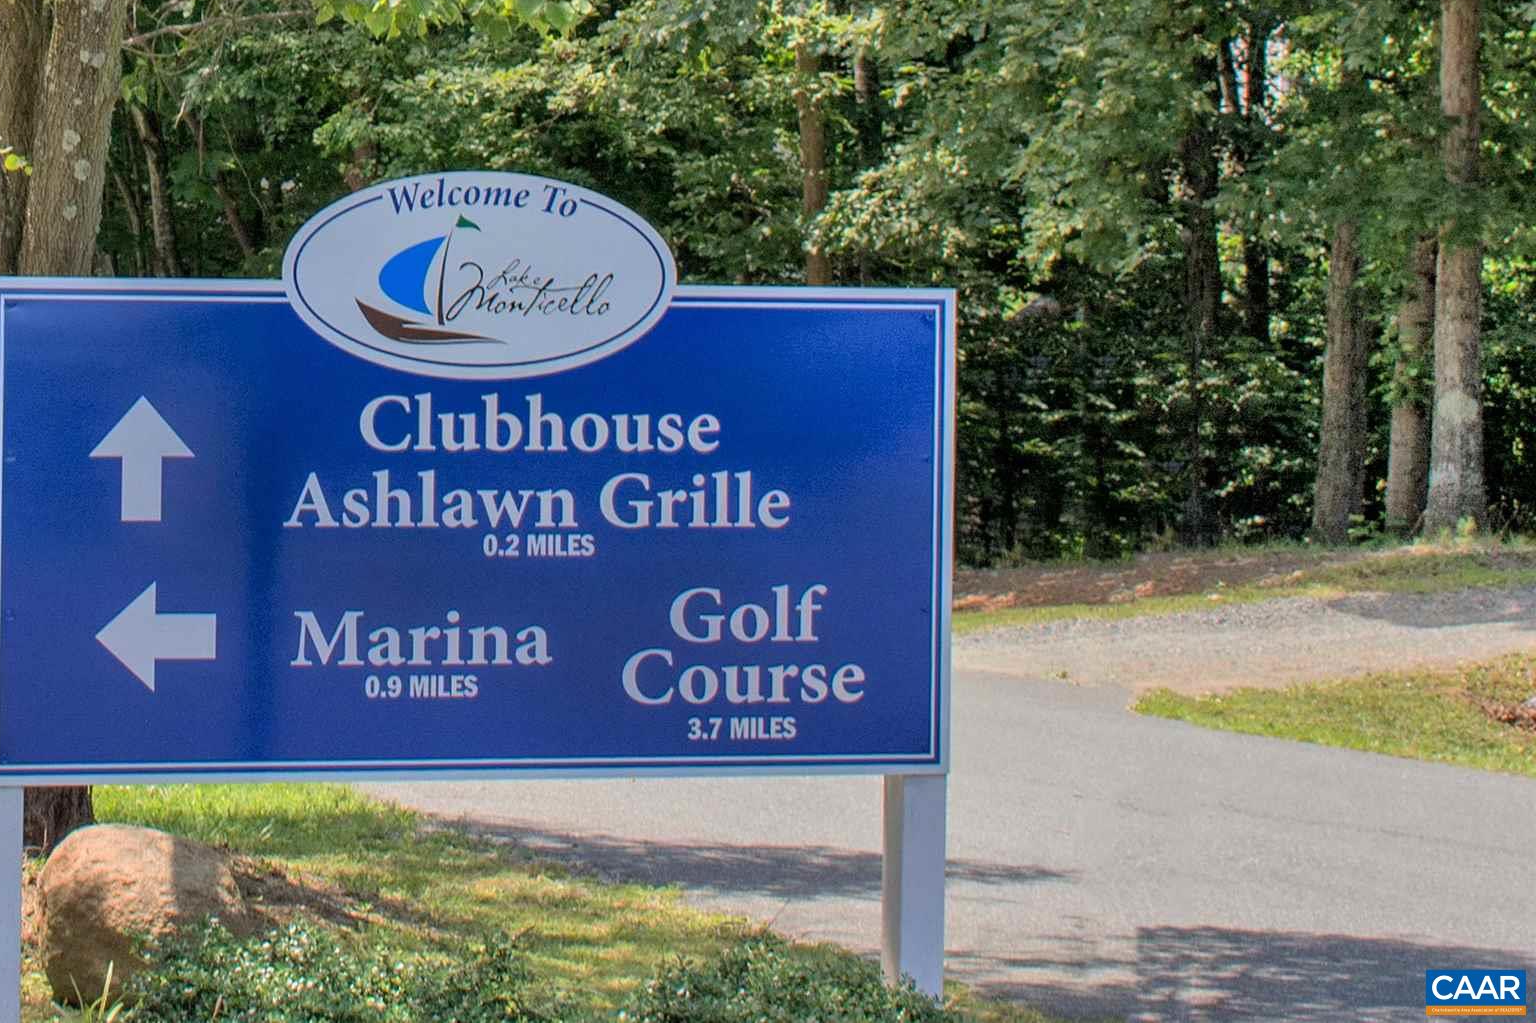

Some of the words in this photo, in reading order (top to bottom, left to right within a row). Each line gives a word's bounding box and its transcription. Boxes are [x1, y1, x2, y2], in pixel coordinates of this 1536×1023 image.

[388, 177, 530, 214] Welcome
[541, 184, 577, 217] To
[446, 262, 614, 321] Monticello
[490, 259, 541, 288] Lake
[360, 392, 720, 452] Clubhouse
[283, 469, 578, 528] Ashlawn
[600, 471, 790, 529] Grille
[483, 534, 520, 557] 0.2
[527, 534, 595, 557] MILES
[290, 610, 553, 666] Marina
[670, 584, 828, 643] Golf
[365, 675, 402, 698] 0.9
[409, 675, 478, 698] MILES
[622, 649, 865, 705] Course
[688, 718, 723, 740] 3.7
[730, 718, 797, 740] MILES
